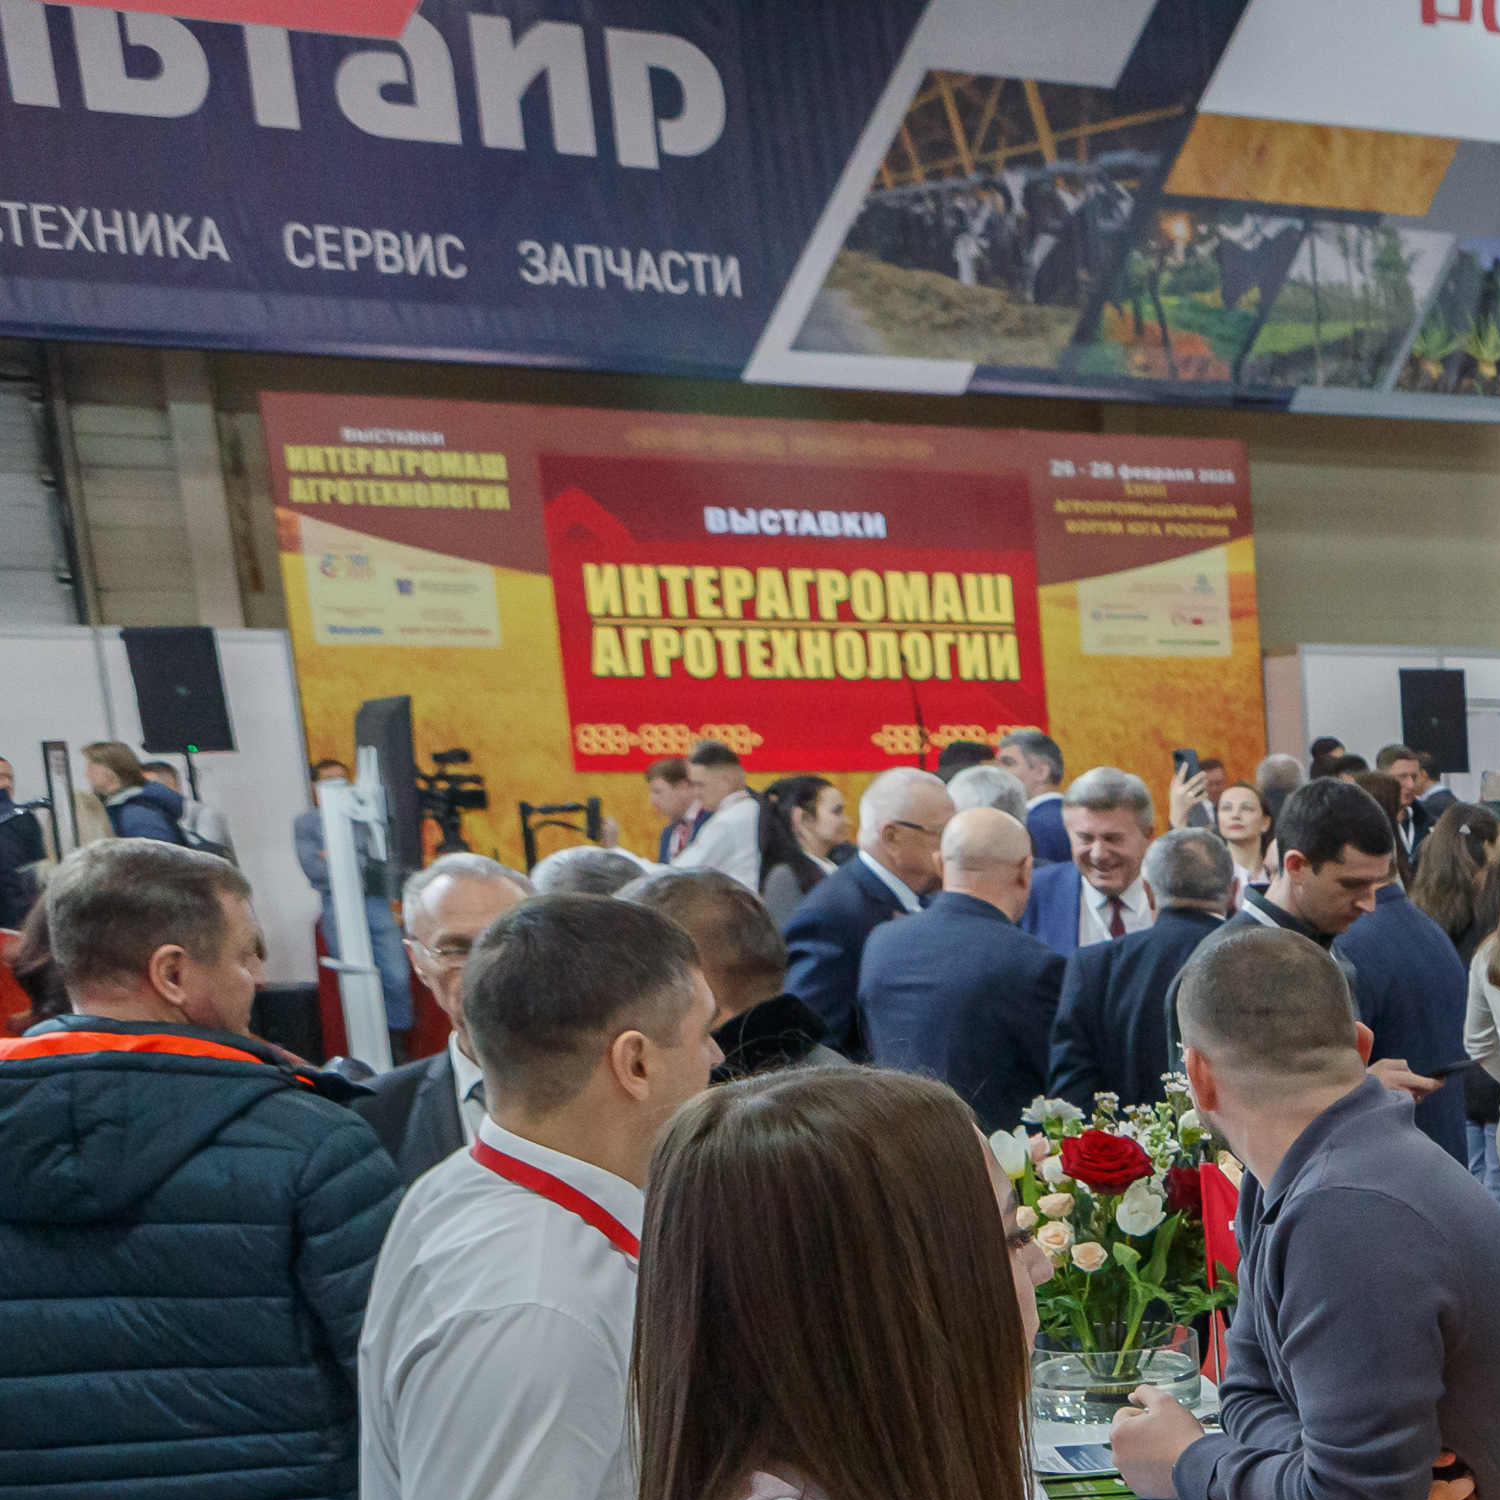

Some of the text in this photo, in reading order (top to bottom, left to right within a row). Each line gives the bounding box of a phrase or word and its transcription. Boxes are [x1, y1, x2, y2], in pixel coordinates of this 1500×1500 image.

[0, 200, 744, 299] ТЕХНИКА СЕРВИС ЗАПЧАСТИ
[283, 444, 508, 480] ИНТЕРАГРОМАШ
[289, 477, 511, 511] АГРОТЕХНОЛОГИИ
[703, 506, 888, 540] ВЫСТАВКИ
[582, 561, 1016, 624] ИНТЕРАГРОМАШ
[591, 626, 1022, 682] АГРОТЕХНОЛОГИИ
